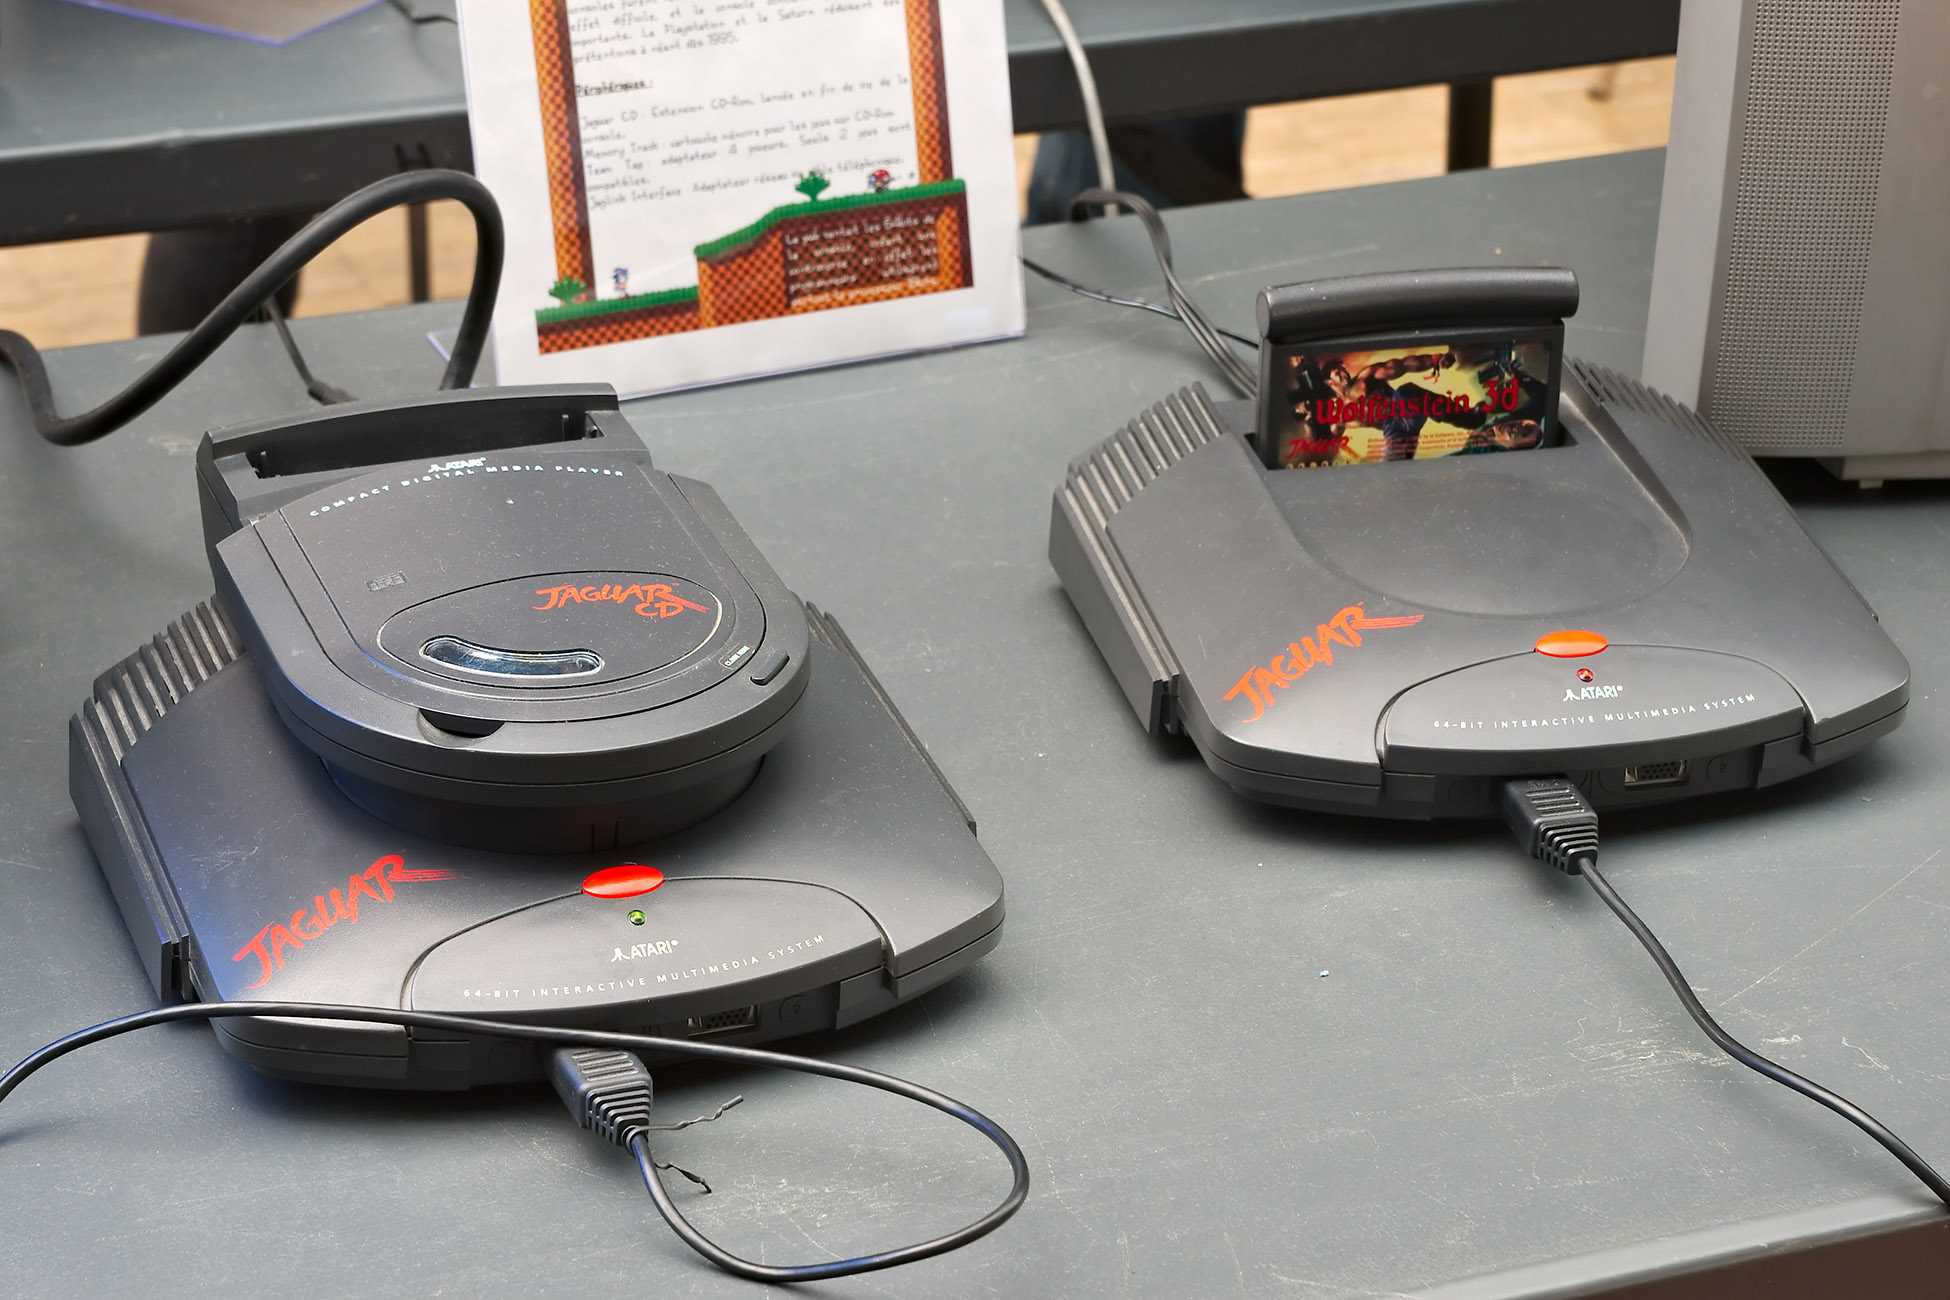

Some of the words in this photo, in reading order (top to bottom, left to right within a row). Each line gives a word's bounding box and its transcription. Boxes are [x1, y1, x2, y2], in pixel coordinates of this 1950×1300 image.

[736, 17, 748, 27] et
[621, 110, 639, 122] CD
[1315, 391, 1471, 425] Wolfenstein
[1482, 374, 1521, 413] 3d
[309, 485, 389, 517] COMPACT
[400, 469, 475, 487] DIGITAL
[485, 465, 544, 473] MEDIA
[555, 465, 624, 477] PLAYER
[532, 582, 710, 614] JAGUAR
[633, 600, 686, 619] CD
[1223, 602, 1425, 722] JAGUAR
[1433, 720, 1484, 729] 64-BIT
[1494, 715, 1595, 729] INTERACTIVE
[1604, 705, 1696, 721] MULTIMEDIA
[1703, 693, 1755, 711] SYSTEM
[232, 854, 455, 987] JAGUAR
[463, 988, 520, 998] 64-BIT
[532, 977, 646, 997] INTERACTIVE
[656, 956, 760, 984] MULTIMEDIA
[767, 935, 825, 960] SYSTEM
